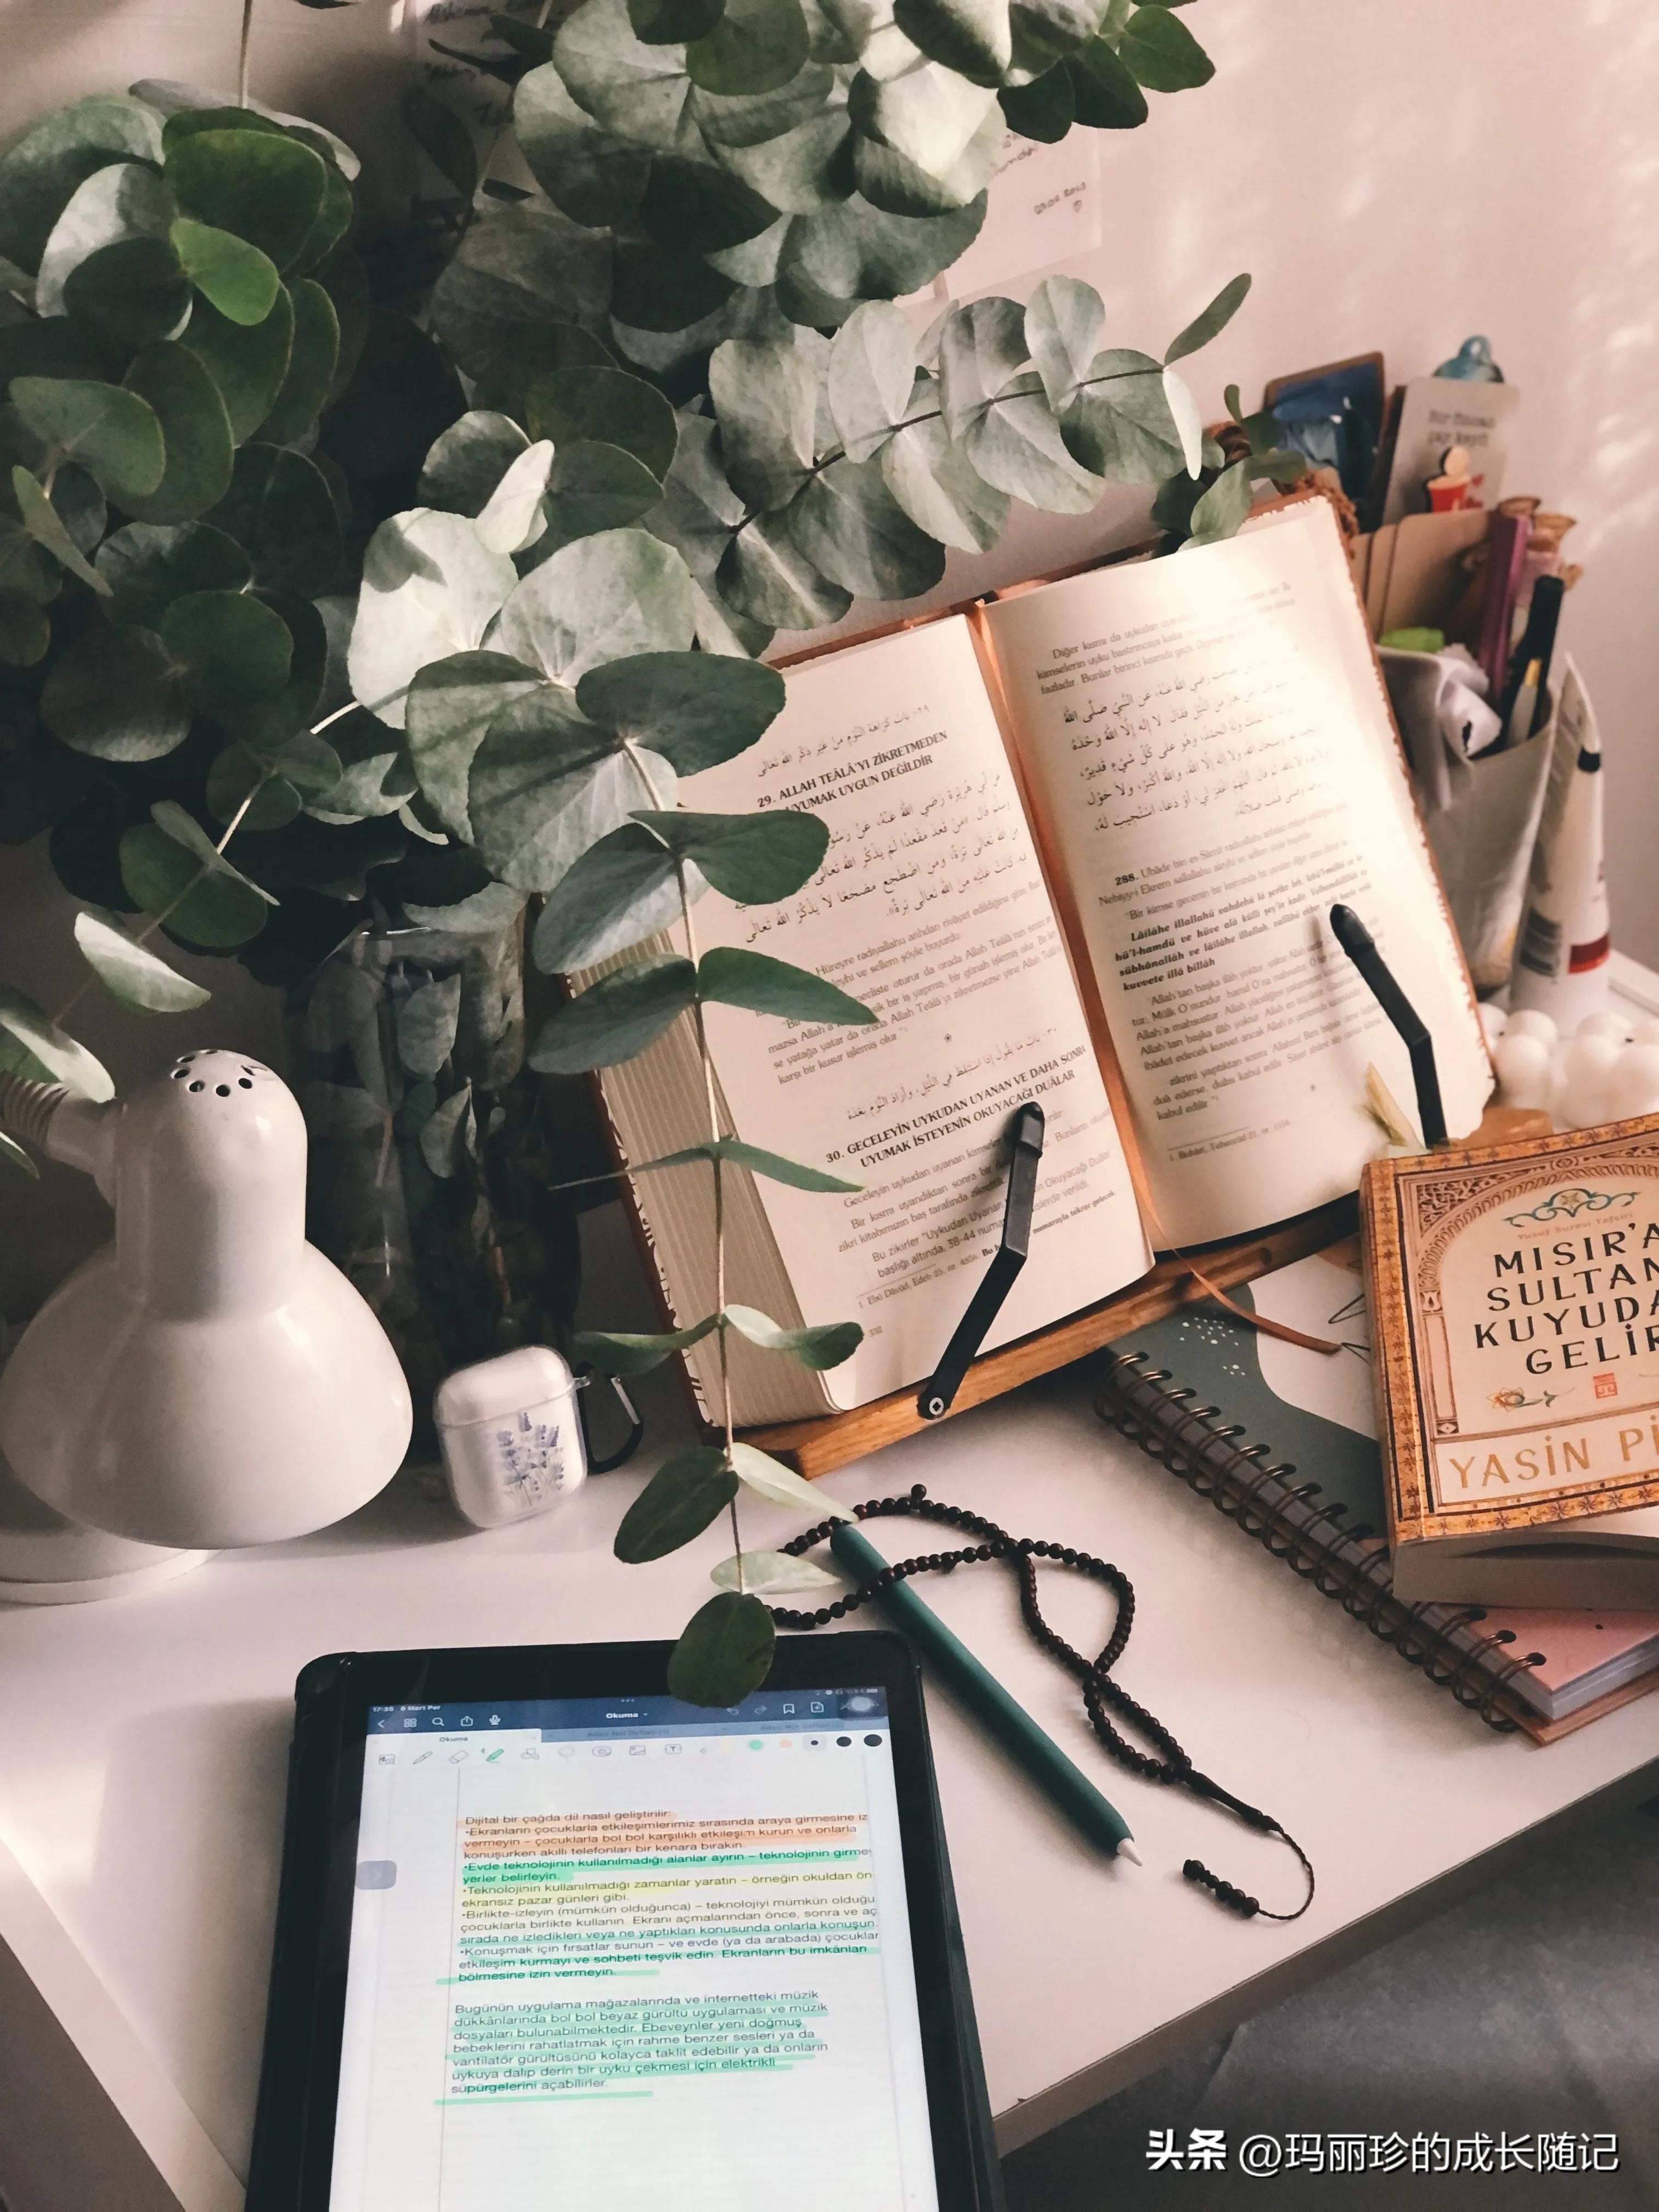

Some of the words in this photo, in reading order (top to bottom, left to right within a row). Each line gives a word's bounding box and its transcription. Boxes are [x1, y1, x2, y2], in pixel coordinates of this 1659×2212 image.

[758, 795, 776, 808] 29.
[780, 778, 817, 800] ALLAH
[872, 732, 947, 766] ZİKRETMEDEN
[838, 774, 879, 796] UYGUN
[881, 754, 933, 781] DEĞİLDİR
[1114, 873, 1139, 887] 288.
[786, 1047, 819, 1066] yatağa
[819, 1036, 844, 1053] yatar
[846, 1030, 859, 1041] da
[777, 1071, 803, 1085] karşı
[802, 1064, 816, 1075] bir
[817, 1053, 843, 1070] kusur
[826, 1150, 845, 1163] 30.
[847, 1122, 911, 1154] GECELEYİN
[912, 1100, 968, 1128] UYKUDAN
[969, 1081, 1012, 1104] UYANAN
[1013, 1072, 1029, 1085] VE
[1029, 1059, 1060, 1079] DAHA
[1060, 1045, 1086, 1065] SONRA
[860, 1140, 912, 1167] UYUMAK
[912, 1115, 972, 1147] İSTEYENİN
[973, 1088, 1034, 1121] OKUYACAĞI
[843, 1185, 890, 1208] Geceleyin
[890, 1169, 931, 1190] uykudan
[932, 1154, 966, 1173] uyanan
[850, 1218, 866, 1230] Bir
[898, 1185, 949, 1211] uyandıktan
[951, 1173, 977, 1188] sonra
[909, 1211, 927, 1222] baş
[871, 1251, 887, 1262] Bu
[1449, 1435, 1590, 1488] YASİN
[465, 1816, 499, 1826] Dijital
[503, 1815, 519, 1824] bir
[522, 1814, 561, 1825] çağda
[564, 1813, 579, 1821] dil
[583, 1812, 611, 1820] nasıl
[461, 1899, 514, 1908] ekransız
[518, 1897, 553, 1907] pazar
[556, 1894, 599, 1905] günleri
[459, 1959, 516, 1970] etkileşim
[520, 1957, 571, 1967] kurmayı
[594, 1954, 641, 1963] sohbeti
[645, 1952, 682, 1963] teşvik
[686, 1950, 714, 1960] edin.
[722, 1948, 785, 1959] Ekranların
[789, 1947, 806, 1955] bu
[810, 1944, 867, 1954] imkânları
[454, 2015, 546, 2027] dükkânlarında
[551, 2013, 571, 2023] bol
[575, 2012, 596, 2022] bol
[600, 2012, 639, 2023] beyaz
[642, 2008, 688, 2021] gürültü
[692, 2006, 766, 2019] uygulaması
[789, 2002, 828, 2013] müzik
[455, 2004, 514, 2016] Bugünün
[518, 2001, 582, 2013] uygulama
[585, 1996, 681, 2010] mağazalarında
[704, 1992, 776, 2004] internetteki
[781, 1990, 819, 2000] müzik
[453, 2029, 513, 2041] dosyaları
[642, 2021, 714, 2033] Ebeveynler
[718, 2021, 744, 2032] yeni
[748, 2017, 802, 2029] doğmuş
[453, 2042, 525, 2053] bebeklerini
[529, 2038, 607, 2050] rahatlatmak
[612, 2038, 634, 2049] için
[684, 2034, 729, 2044] benzer
[733, 2030, 775, 2041] sesleri
[778, 2032, 794, 2042] ya
[798, 2029, 815, 2039] da
[517, 2051, 596, 2066] gürültüsünü
[601, 2050, 652, 2062] kolayca
[655, 2047, 687, 2058] taklit
[691, 2045, 740, 2056] edebilir
[743, 2046, 759, 2057] ya
[763, 2044, 780, 2053] da
[783, 2042, 828, 2053] onların
[452, 2070, 499, 2082] uykuya
[503, 2068, 536, 2079] dalıp
[540, 2067, 573, 2076] derin
[578, 2065, 595, 2075] bir
[599, 2064, 630, 2076] uyku
[635, 2061, 690, 2075] çekmesi
[694, 2060, 716, 2072] için
[721, 2057, 775, 2069] elektrikli
[452, 2081, 537, 2095] süpürgelerini
